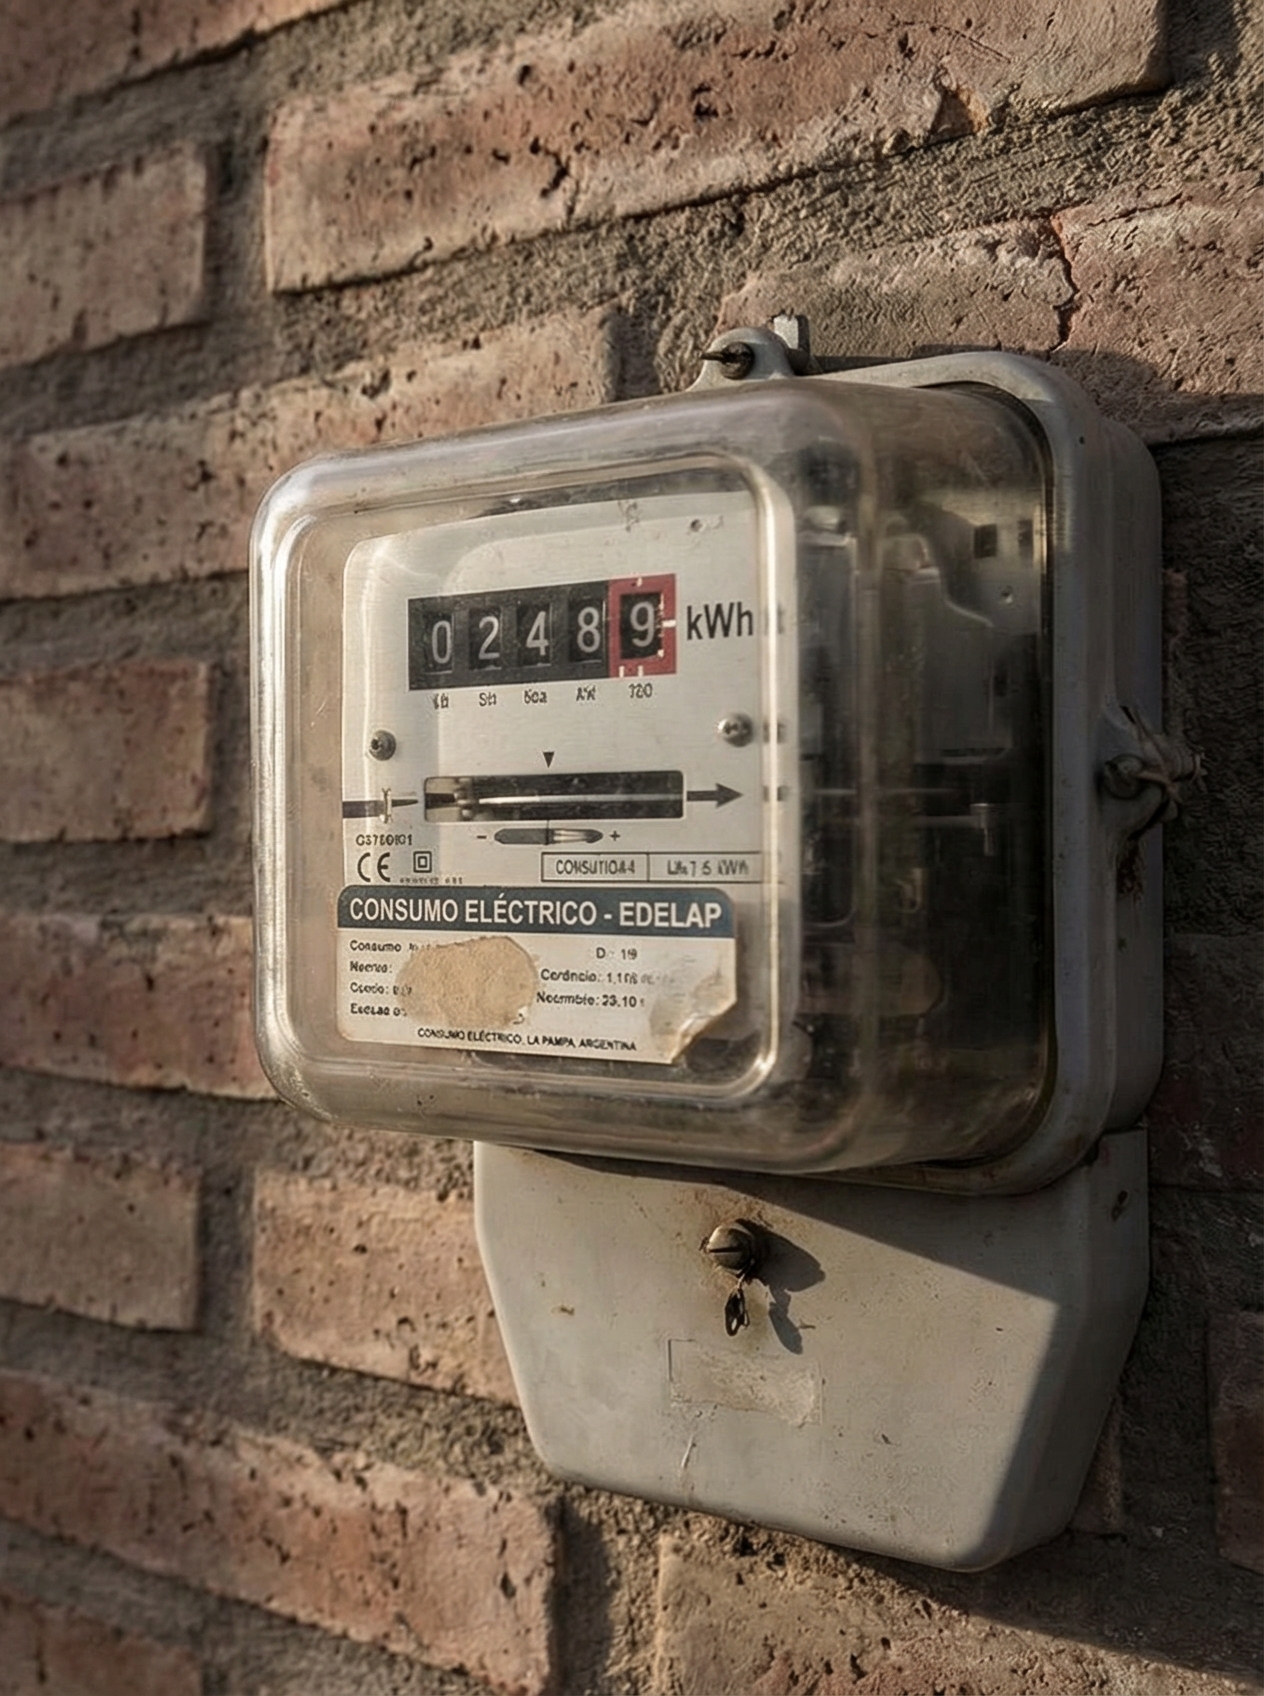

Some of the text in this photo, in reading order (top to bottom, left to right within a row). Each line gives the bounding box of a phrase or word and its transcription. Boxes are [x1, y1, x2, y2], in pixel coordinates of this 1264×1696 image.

[686, 601, 754, 640] kWh
[357, 852, 391, 882] CE
[349, 898, 459, 922] CONSUMO
[464, 893, 598, 926] ELÉCTRICO
[619, 902, 722, 928] EDELAP
[349, 940, 402, 951] Consumo
[527, 1036, 540, 1046] LA
[578, 1039, 638, 1051] ARGENTINA
